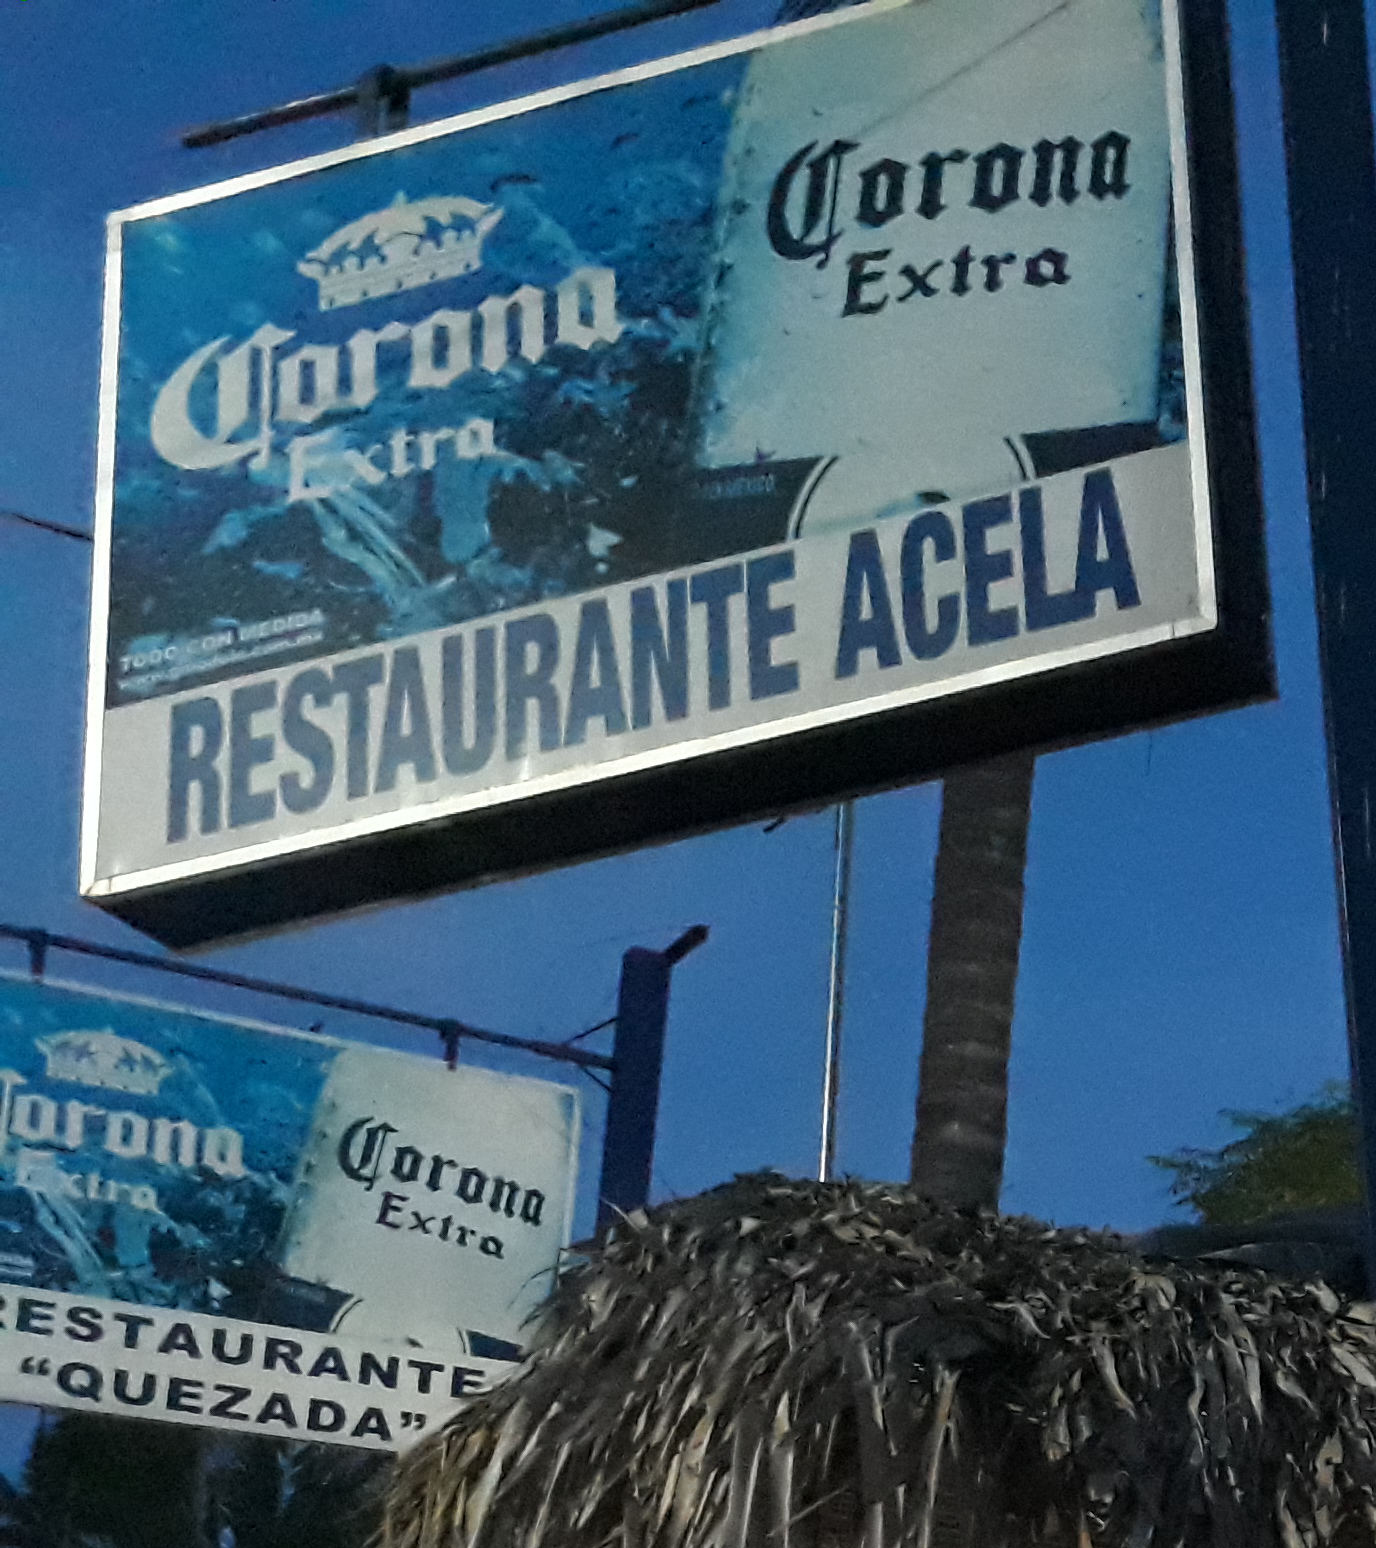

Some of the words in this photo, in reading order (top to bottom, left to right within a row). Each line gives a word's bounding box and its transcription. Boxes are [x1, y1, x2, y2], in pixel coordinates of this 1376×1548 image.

[766, 130, 1134, 268] Corona
[841, 246, 1073, 318] Extra
[150, 266, 630, 474] Corona
[287, 415, 499, 502] Extra
[165, 547, 802, 846] RESTAURANTE
[834, 466, 1142, 682] ACELA
[15, 1151, 162, 1211] Extra
[338, 1115, 547, 1229] Corona
[375, 1191, 505, 1261] Extra
